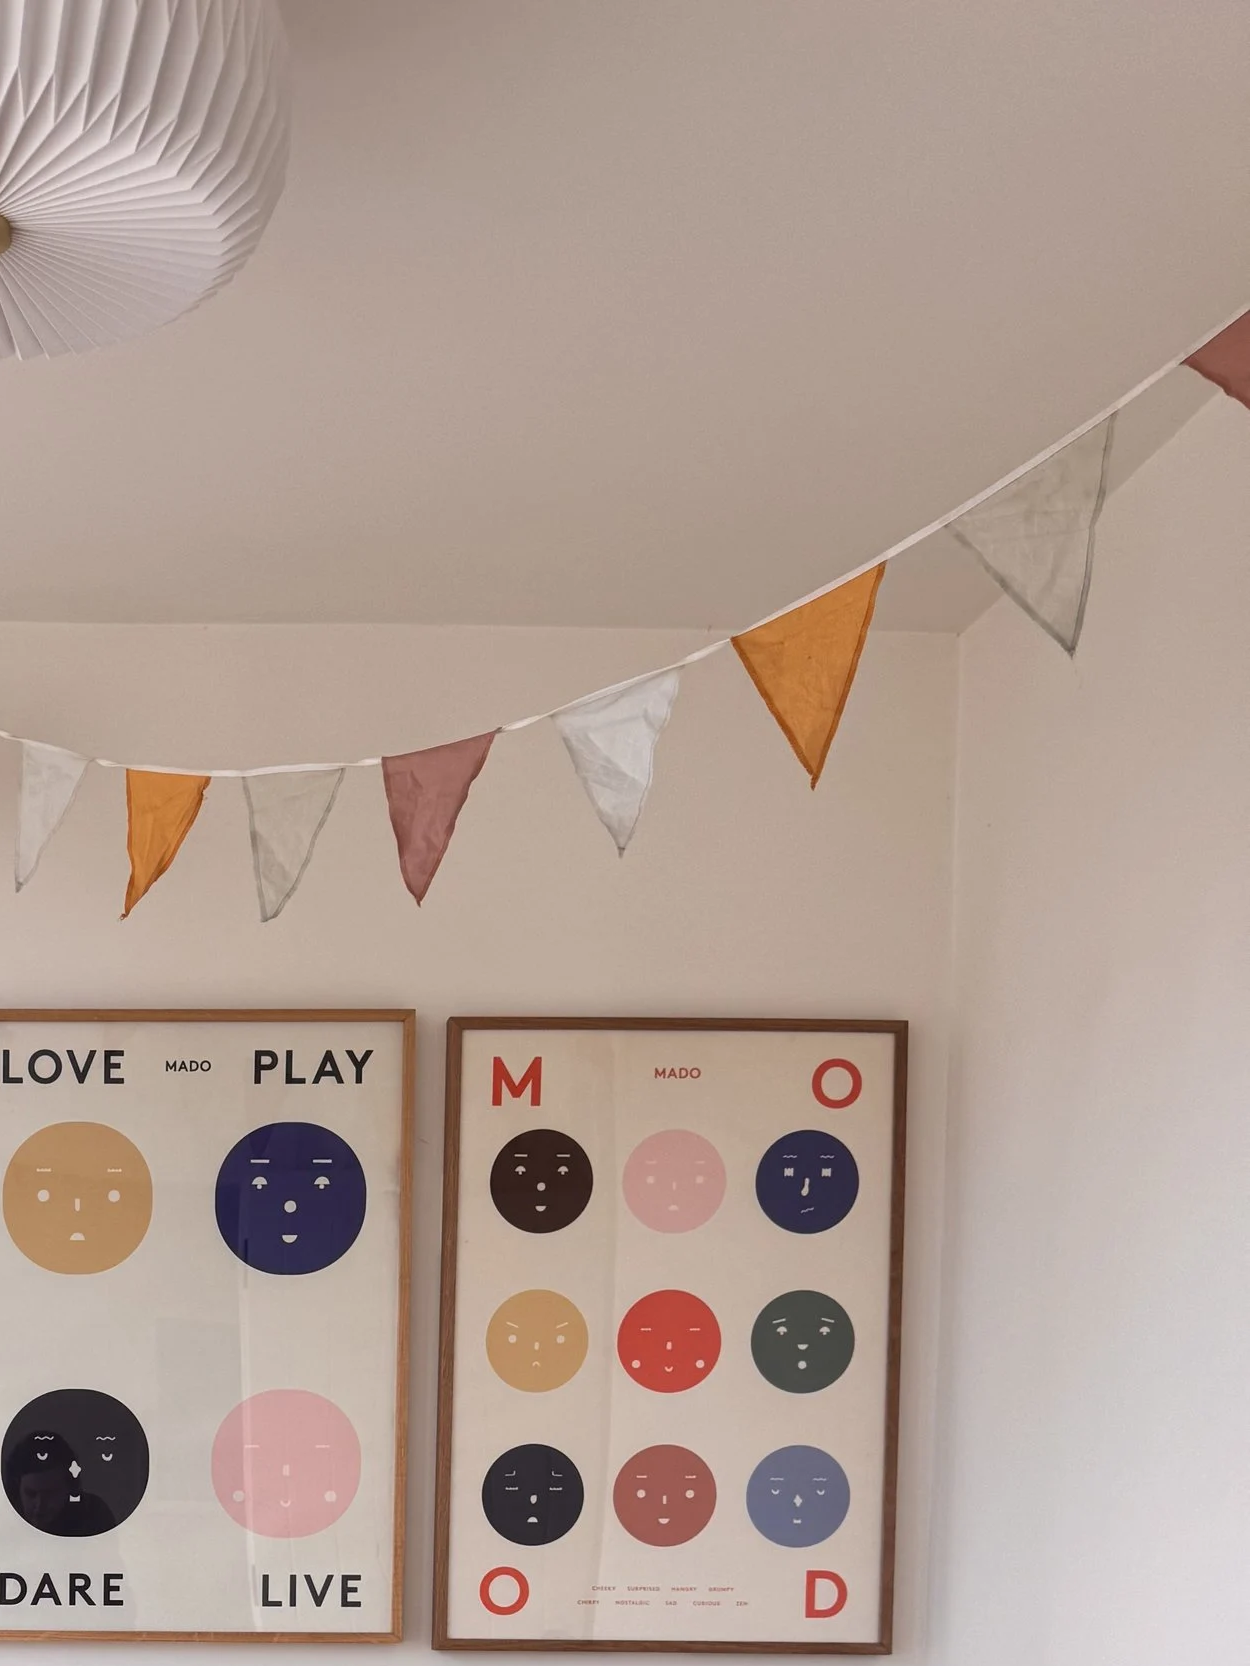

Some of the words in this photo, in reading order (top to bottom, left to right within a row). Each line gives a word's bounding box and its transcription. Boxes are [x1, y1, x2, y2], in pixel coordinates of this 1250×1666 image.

[2, 1049, 125, 1085] LOVE
[165, 1060, 212, 1073] MADO
[253, 1049, 375, 1085] PLAY
[490, 1055, 543, 1108] M
[653, 1066, 702, 1080] MADO
[811, 1057, 863, 1111] O
[0, 1572, 124, 1607] DARE
[261, 1574, 362, 1608] LIVE
[478, 1565, 530, 1617] O
[804, 1569, 848, 1620] D
